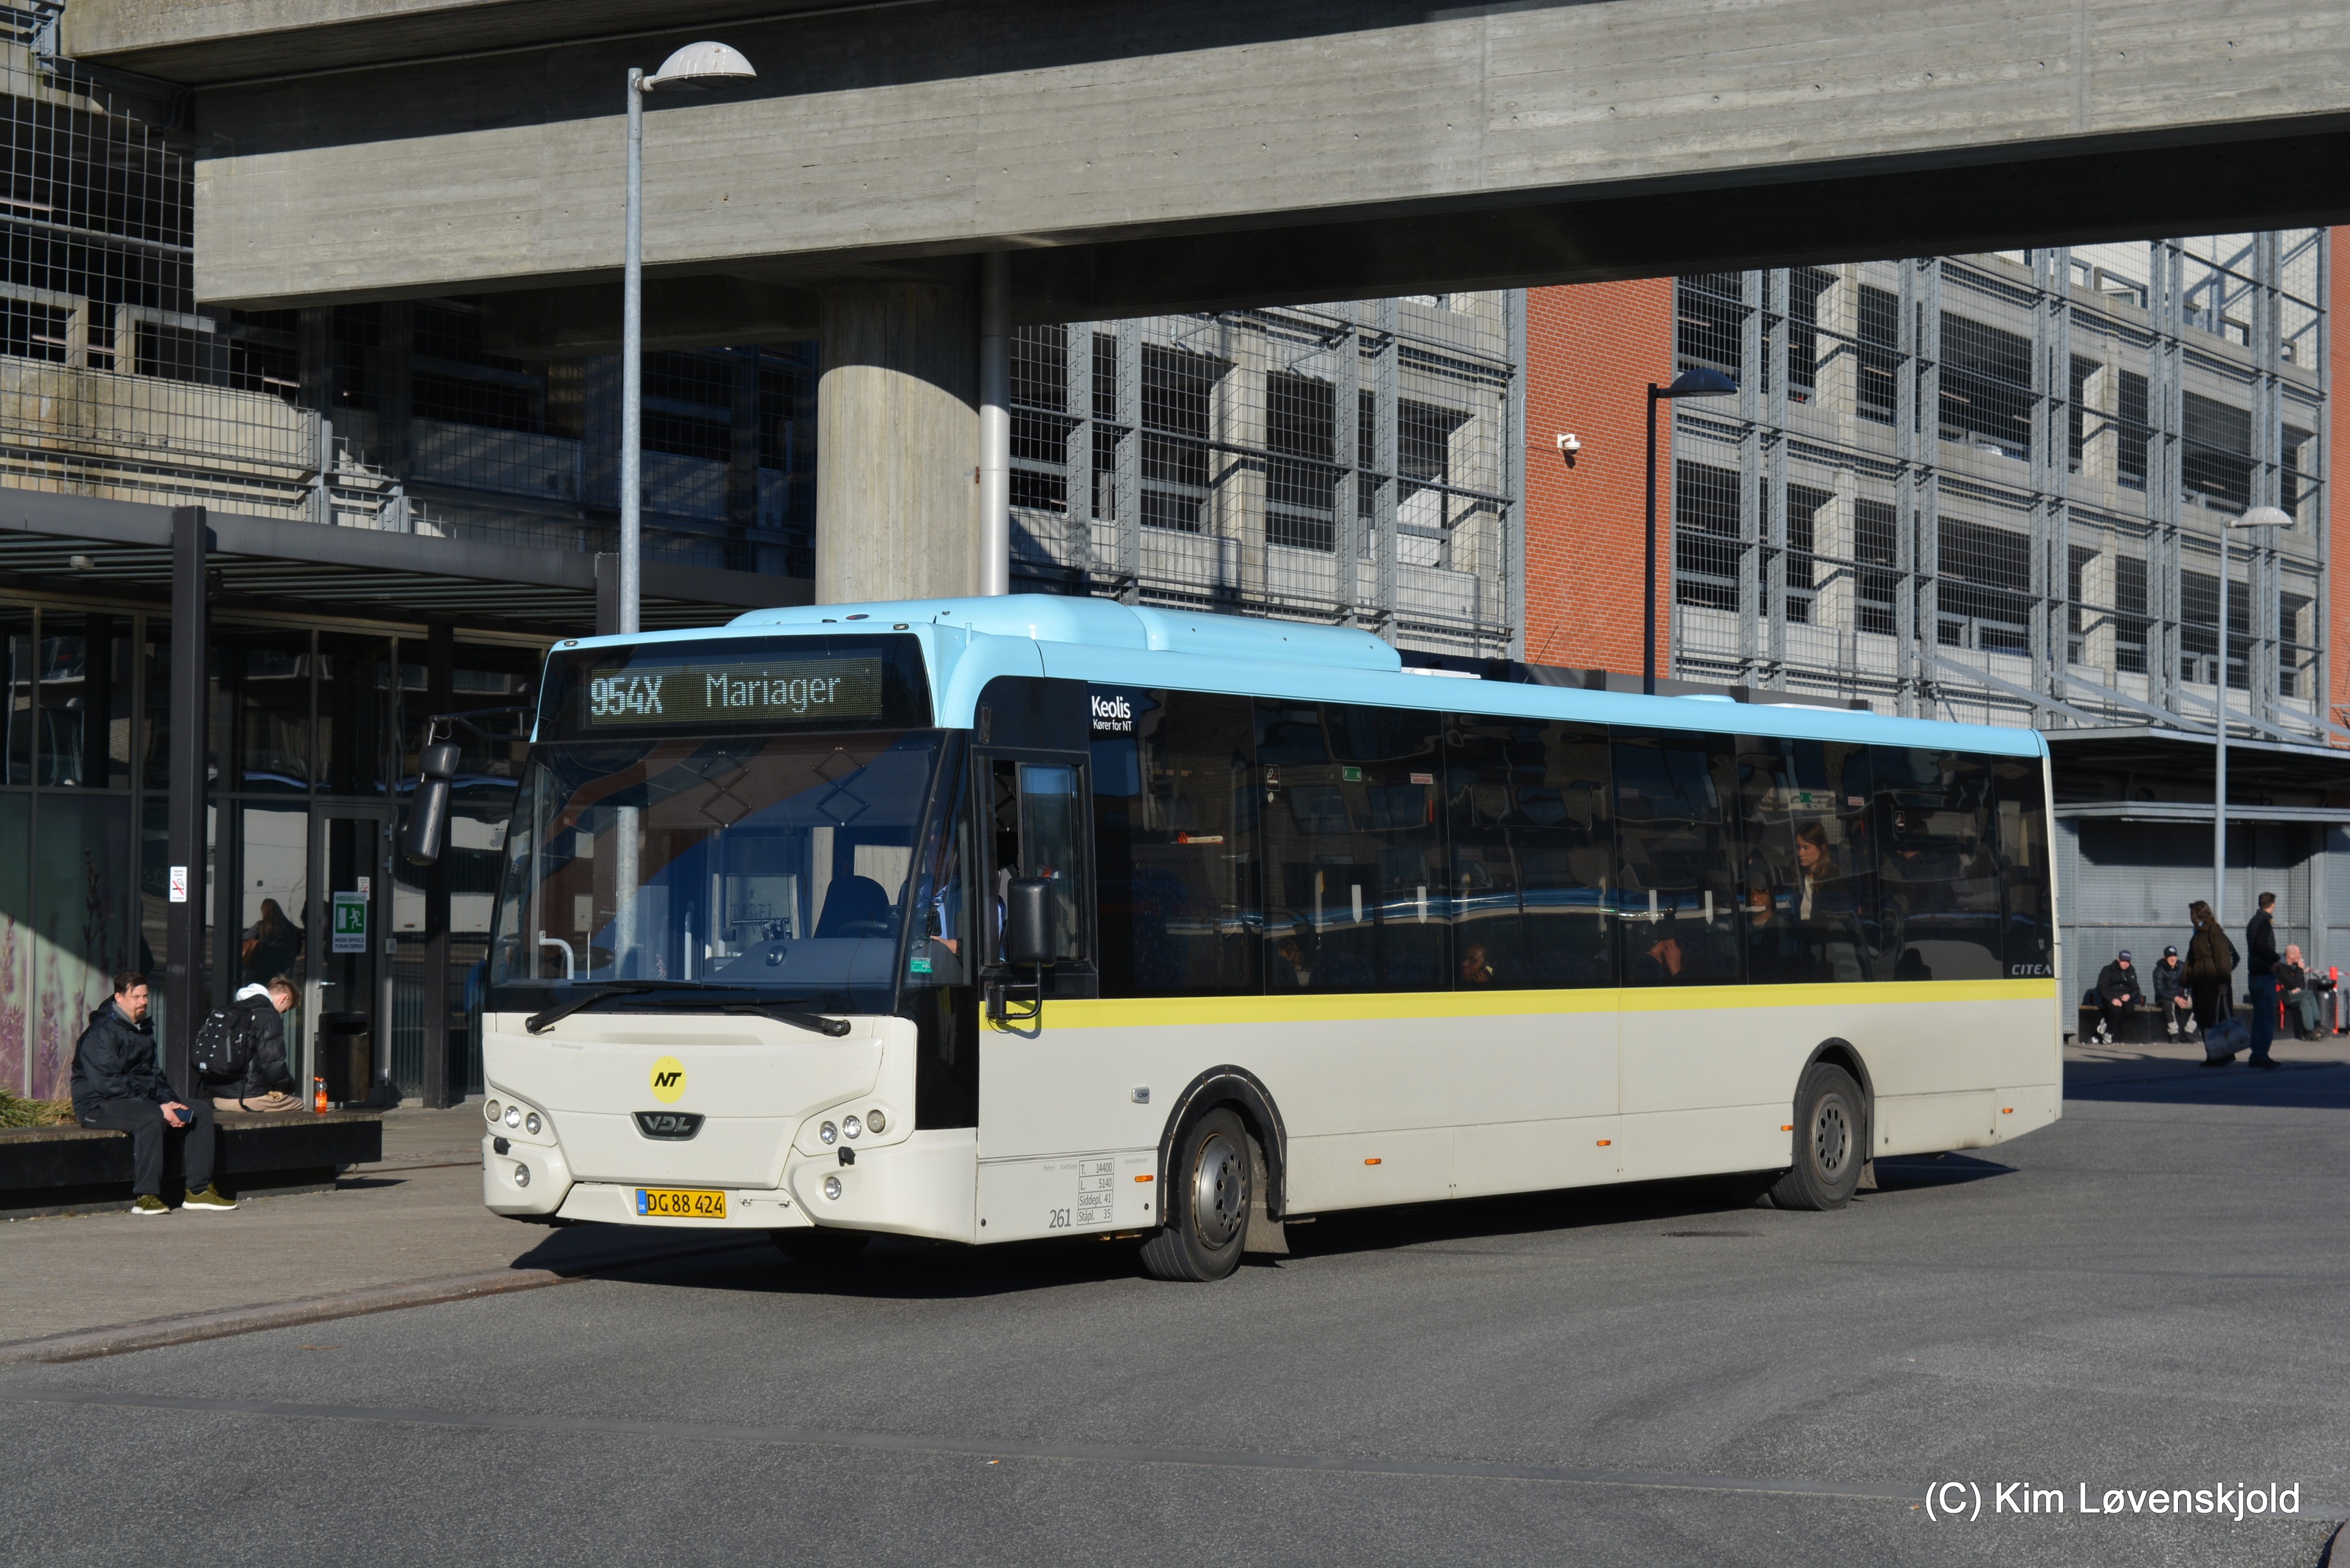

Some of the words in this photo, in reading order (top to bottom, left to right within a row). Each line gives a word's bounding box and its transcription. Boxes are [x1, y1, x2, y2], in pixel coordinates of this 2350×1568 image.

[591, 676, 663, 715] 954X
[706, 672, 841, 713] Mariager
[1091, 695, 1131, 719] Keolis
[1093, 719, 1111, 730] Kører
[1112, 719, 1122, 731] for
[1122, 720, 1132, 731] NT
[2012, 964, 2052, 975] CITEA
[654, 1072, 682, 1087] NT
[643, 1115, 692, 1132] VDL
[1081, 1164, 1086, 1174] T.
[1096, 1162, 1113, 1173] 14400
[1081, 1180, 1086, 1190] L.
[1099, 1177, 1113, 1188] 5140
[647, 1194, 669, 1212] DG
[672, 1194, 690, 1213] 88
[695, 1195, 723, 1214] 424
[1079, 1194, 1102, 1208] Siddepl.
[1104, 1193, 1111, 1203] 41
[1049, 1208, 1072, 1228] 261
[1078, 1209, 1095, 1223] Ståpl.
[1103, 1209, 1111, 1219] 35
